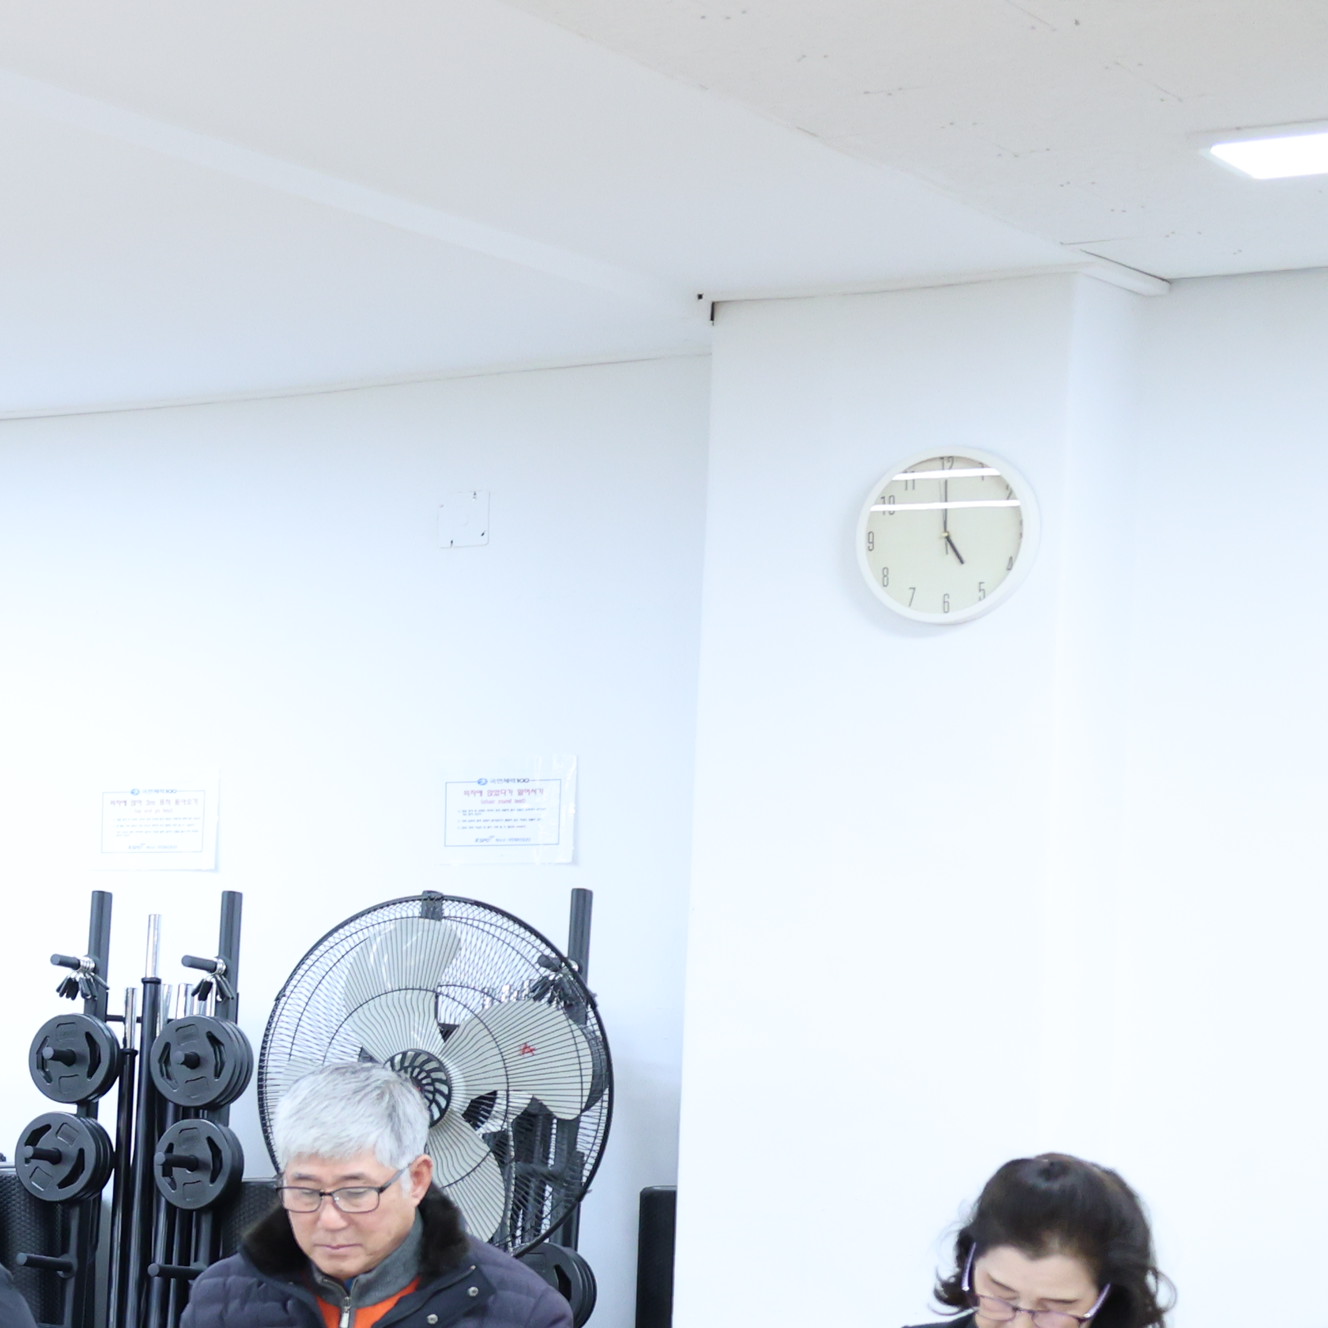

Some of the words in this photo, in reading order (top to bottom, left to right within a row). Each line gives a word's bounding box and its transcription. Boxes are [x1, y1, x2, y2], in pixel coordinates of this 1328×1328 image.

[867, 531, 875, 551] 9
[881, 567, 889, 587] 8
[907, 587, 916, 607] 7
[978, 582, 986, 601] 5
[943, 594, 950, 613] 6
